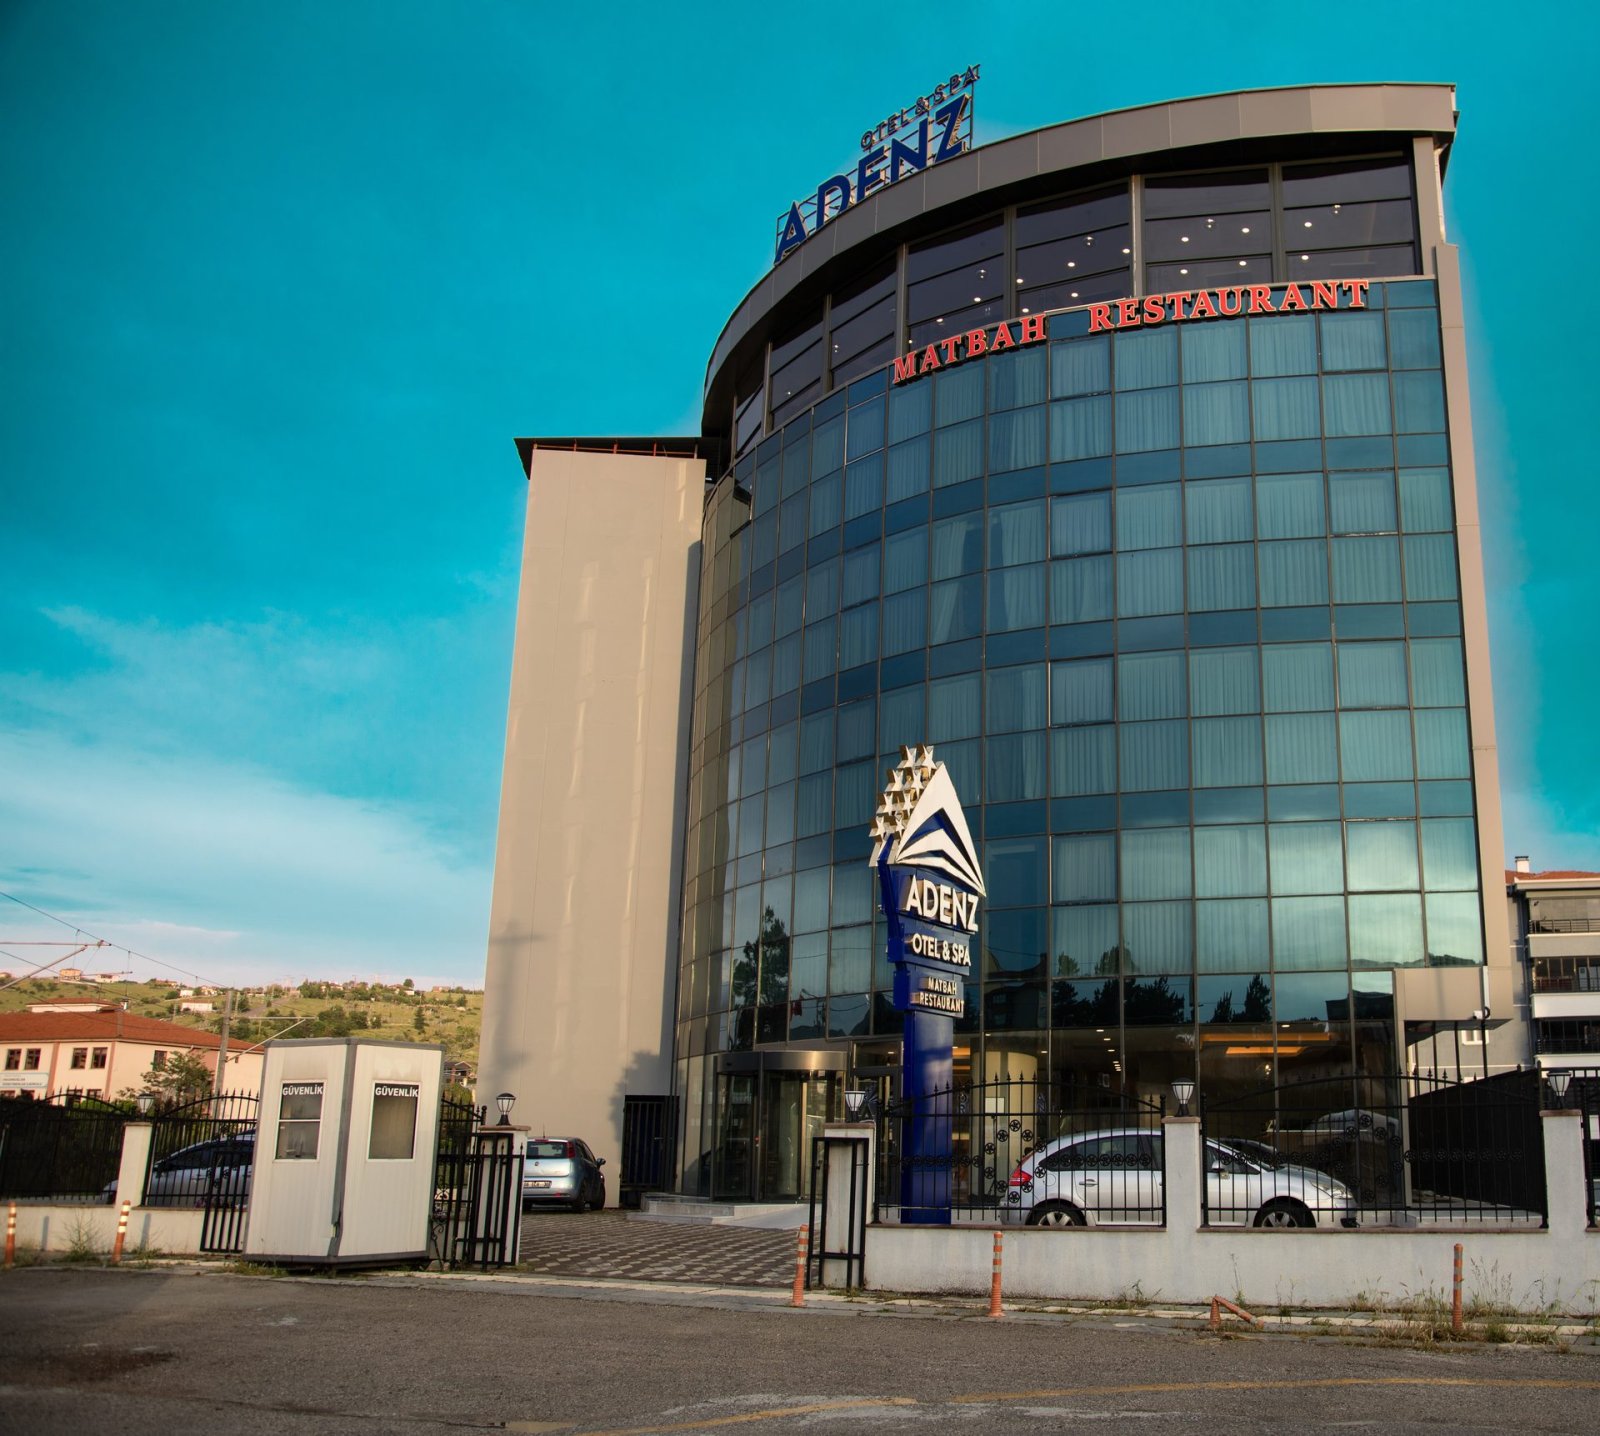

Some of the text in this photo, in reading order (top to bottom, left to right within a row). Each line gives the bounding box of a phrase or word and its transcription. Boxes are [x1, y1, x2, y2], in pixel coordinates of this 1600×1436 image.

[861, 65, 978, 149] OTEL & SPA
[773, 93, 970, 265] ADENZ
[892, 278, 1370, 385] MATBAH RESTAURANT
[905, 874, 979, 932] ADENZ
[912, 933, 971, 966] OTEL & SPA
[920, 991, 965, 1013] RESTAURANT
[928, 976, 957, 995] MATBAH
[282, 1084, 323, 1096] GÜVENLİK
[375, 1086, 419, 1098] GÜVENLİK
